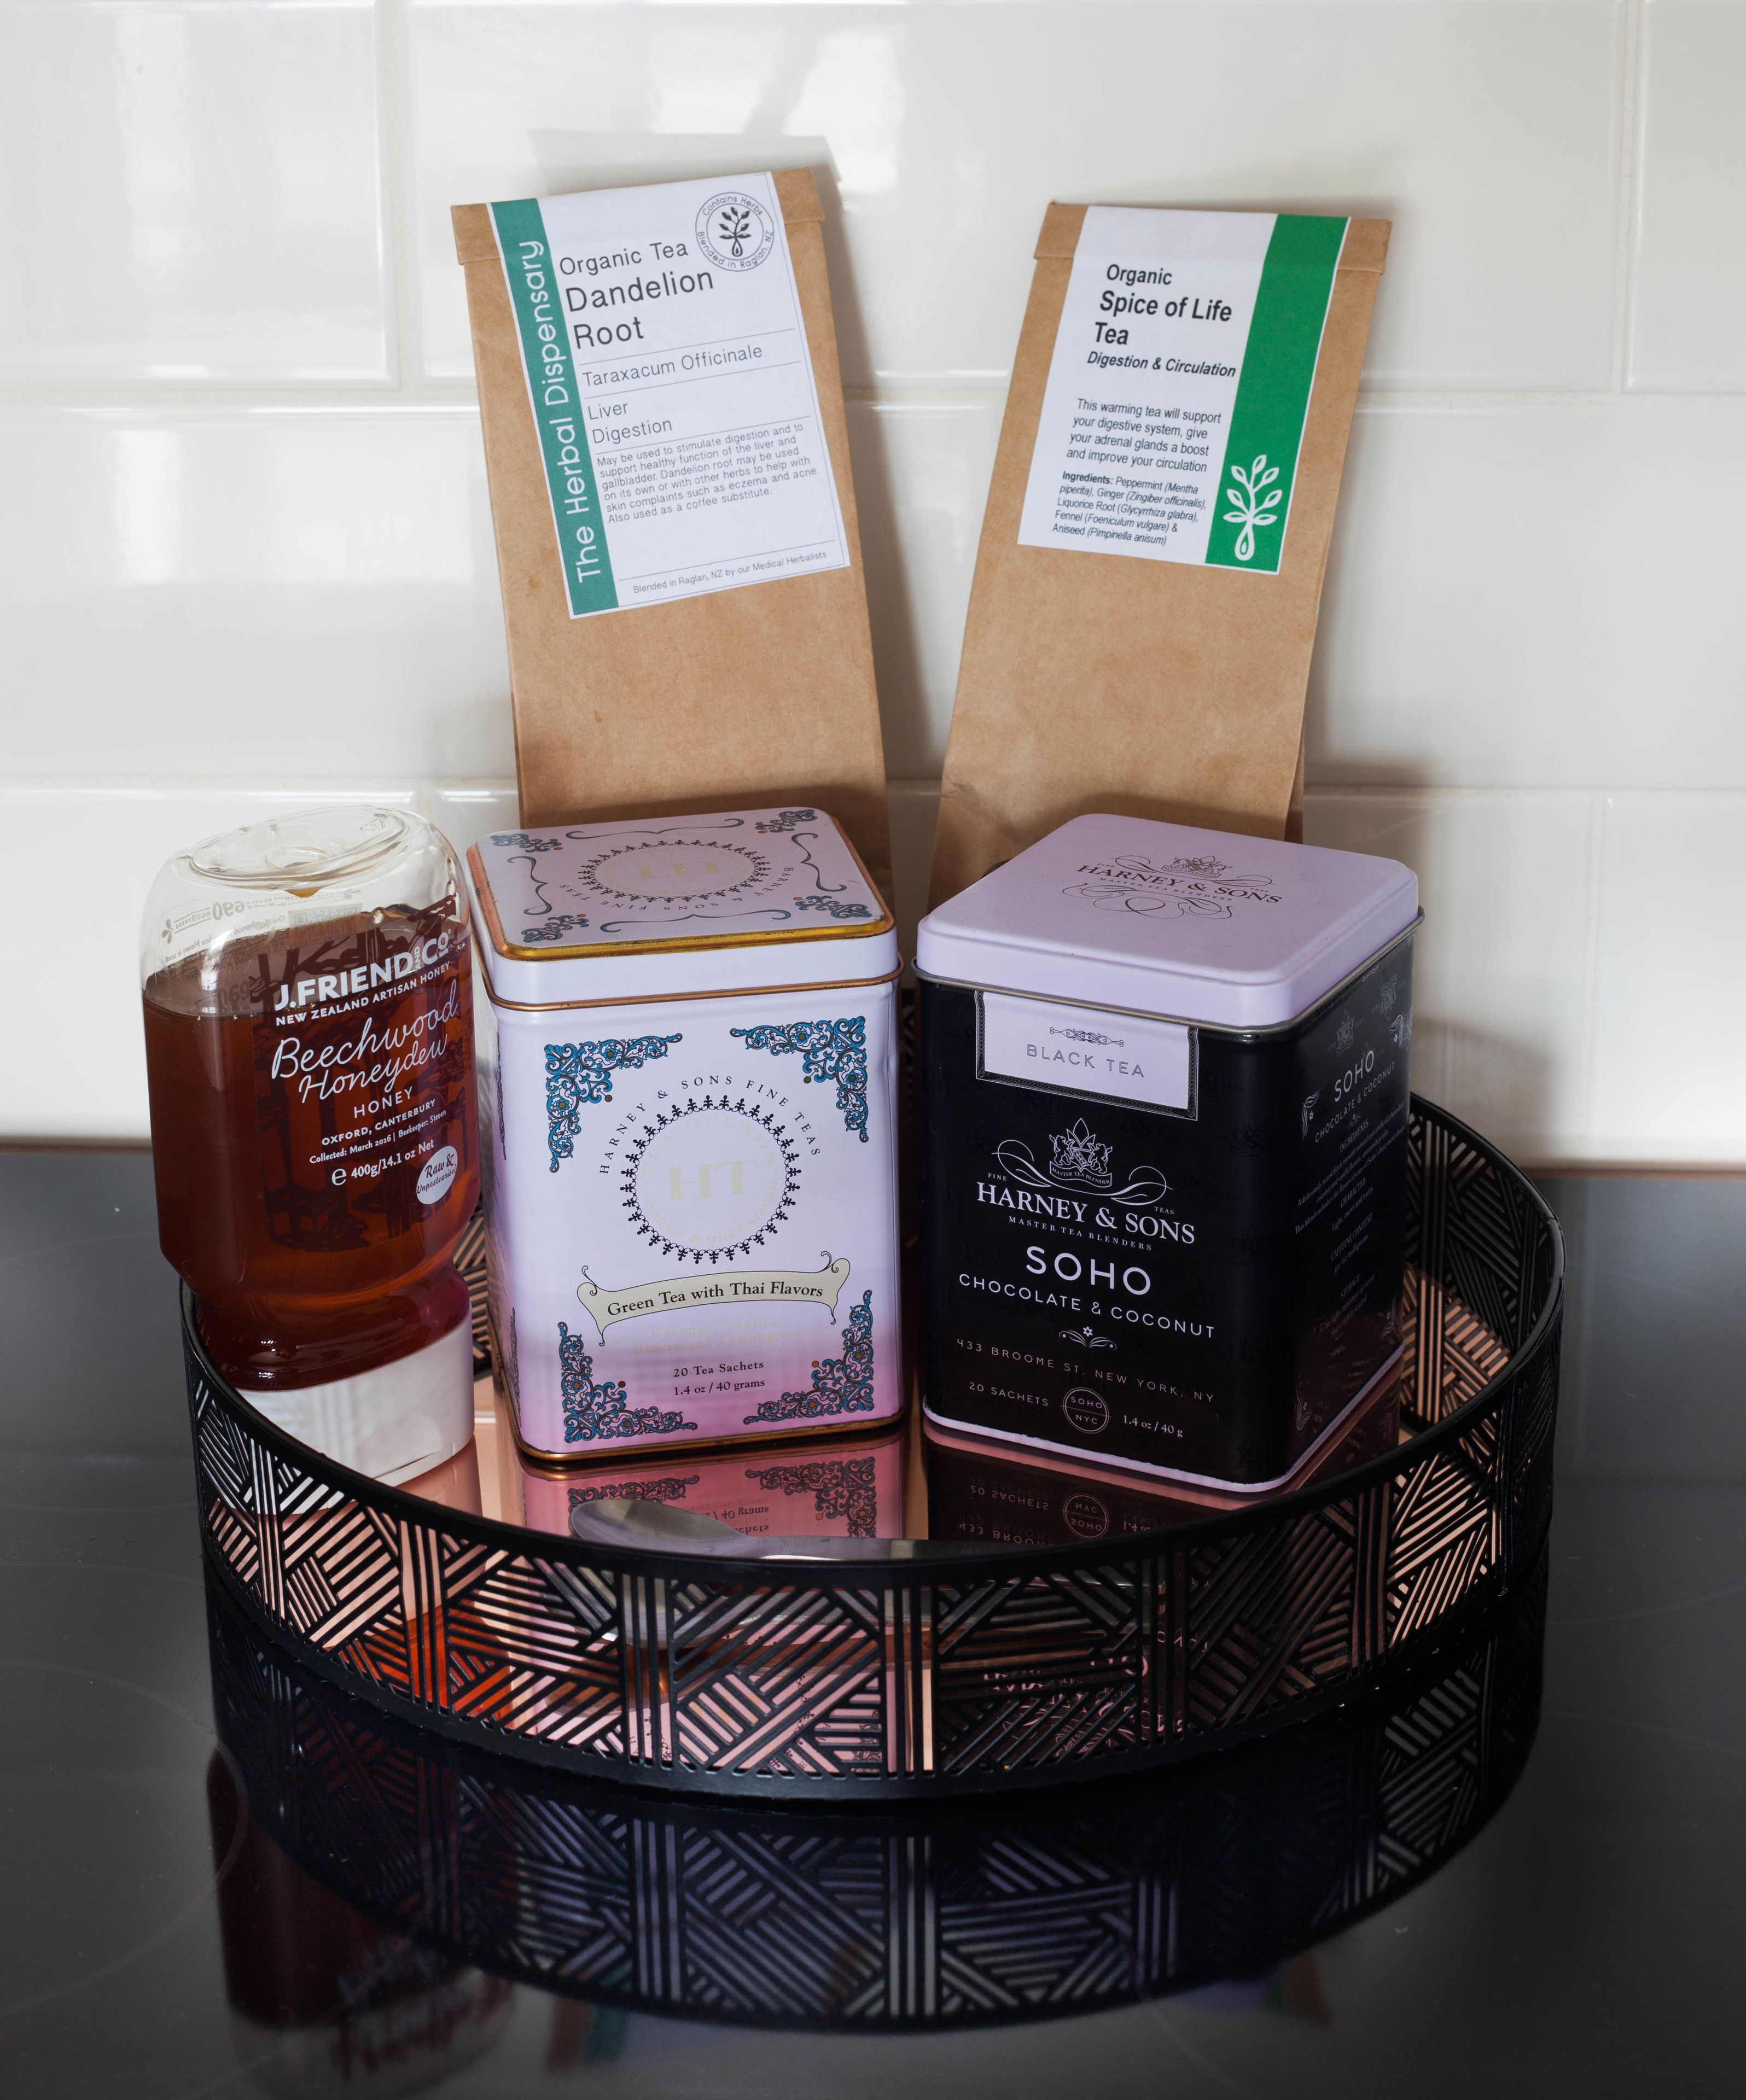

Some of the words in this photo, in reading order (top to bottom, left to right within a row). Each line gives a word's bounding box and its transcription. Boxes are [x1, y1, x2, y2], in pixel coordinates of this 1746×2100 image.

[560, 248, 641, 276] Organic
[649, 242, 688, 260] Tea
[1107, 264, 1172, 286] Organic
[566, 271, 713, 312] Dandelion
[1100, 290, 1158, 317] Spice
[1165, 297, 1188, 317] of
[1192, 299, 1231, 322] Life
[519, 241, 568, 405] Dispensary
[573, 317, 644, 349] Root
[1096, 322, 1128, 345] Tea
[582, 362, 675, 386] Taraxacum
[682, 345, 762, 370] Officinale
[1087, 351, 1148, 369] Digestion
[1152, 357, 1161, 370] &
[1166, 358, 1236, 377] Circulation
[588, 403, 627, 420] Liver
[1073, 417, 1095, 428] your
[1098, 417, 1142, 431] digestive
[1144, 424, 1182, 437] system,
[1186, 427, 1207, 440] give
[1078, 398, 1097, 410] This
[1101, 404, 1142, 418] warming
[1145, 406, 1161, 417] tea
[1165, 408, 1180, 418] will
[1183, 411, 1221, 424] support
[592, 420, 672, 444] Digestion
[597, 457, 616, 466] May
[620, 453, 633, 462] be
[636, 447, 660, 459] used
[663, 447, 673, 455] to
[677, 438, 721, 452] stimulate
[725, 430, 769, 445] digestion
[773, 424, 790, 435] and
[1069, 434, 1092, 444] your
[1095, 434, 1132, 447] adrenal
[1134, 438, 1168, 451] glands
[1171, 444, 1178, 452] a
[1180, 442, 1209, 456] boost
[549, 417, 589, 514] Herbal
[600, 464, 637, 478] support
[640, 458, 676, 470] healthy
[679, 451, 719, 463] function
[722, 446, 731, 456] of
[735, 445, 751, 453] the
[754, 440, 773, 450] liver
[778, 435, 796, 446] and
[602, 474, 657, 492] gallbladder.
[660, 464, 709, 479] Dandelion
[713, 458, 732, 469] root
[736, 456, 755, 465] may
[759, 453, 771, 461] be
[775, 446, 799, 458] used
[1067, 448, 1086, 459] and
[1088, 449, 1128, 463] improve
[1131, 456, 1154, 467] your
[1156, 457, 1207, 472] circulation
[606, 501, 626, 512] skin
[630, 492, 683, 508] complaints
[687, 486, 709, 498] such
[729, 477, 768, 489] eczema
[772, 471, 789, 482] and
[793, 468, 818, 479] acne.
[1062, 471, 1113, 484] Ingredients:
[1116, 476, 1162, 490] Peppermint
[1165, 482, 1198, 494] (Mentha
[608, 514, 630, 523] Also
[633, 506, 657, 518] used
[661, 506, 672, 514] as
[686, 497, 717, 509] coffee
[721, 488, 772, 503] substitute.
[576, 526, 601, 582] The
[1075, 865, 1185, 887] HARNEY
[1188, 883, 1206, 891] &
[1215, 887, 1282, 903] SONS
[275, 952, 414, 1011] J.FRIEND
[276, 1013, 307, 1026] NEW
[311, 996, 369, 1019] ZEALAND
[373, 979, 417, 1003] ARTISAN
[420, 961, 451, 983] HONEY
[271, 979, 458, 1079] Beechwood
[299, 1034, 447, 1104] Honeydew
[1026, 1043, 1095, 1070] BLACK
[1107, 1059, 1145, 1078] TEA
[1334, 1050, 1375, 1102] SOHO
[354, 1087, 412, 1118] HONEY
[310, 1149, 347, 1164] Collected:
[350, 1140, 373, 1154] March
[375, 1136, 391, 1146] 2016
[398, 1120, 428, 1138] Beekeeper:
[430, 1110, 446, 1124] Steven
[322, 1127, 372, 1145] OXFORD,
[375, 1099, 435, 1130] CANTERBURY
[600, 1101, 647, 1175] HARNEY
[657, 1089, 669, 1100] &
[682, 1076, 732, 1090] SONS
[746, 1080, 790, 1109] FINE
[794, 1111, 820, 1156] TEAS
[351, 1153, 402, 1178] 400g/14.1
[405, 1150, 416, 1160] oz
[418, 1140, 434, 1154] Net
[424, 1163, 444, 1178] Raw
[446, 1153, 455, 1168] &
[416, 1164, 457, 1194] Unpasteurised
[665, 1159, 758, 1201] HT
[988, 1172, 1008, 1182] FINE
[976, 1182, 1087, 1223] HARNEY
[1096, 1208, 1118, 1229] &
[1125, 1212, 1195, 1245] SONS
[1154, 1206, 1175, 1215] TEAS
[1009, 1216, 1056, 1231] MASTER
[1061, 1227, 1082, 1237] TEA
[1089, 1232, 1152, 1251] BLENDERS
[1026, 1246, 1150, 1295] SOHO
[607, 1297, 654, 1316] Green
[659, 1291, 686, 1305] Tea
[690, 1284, 724, 1300] with
[730, 1281, 766, 1296] Thai
[770, 1282, 824, 1297] Flavors
[959, 1274, 1081, 1311] CHOCOLATE
[1091, 1302, 1101, 1315] &
[1111, 1306, 1215, 1338] COCONUT
[673, 1367, 689, 1378] 20
[694, 1365, 714, 1375] Tea
[719, 1361, 764, 1373] Sachets
[957, 1338, 982, 1352] 433
[992, 1347, 1054, 1368] BROOME
[1064, 1363, 1085, 1375] ST.
[1095, 1370, 1127, 1384] NEW
[1137, 1379, 1183, 1398] YORK,
[1194, 1391, 1215, 1402] NY
[673, 1384, 690, 1396] 1.4
[694, 1384, 706, 1394] oz
[708, 1382, 713, 1393] /
[716, 1381, 730, 1392] 40
[734, 1379, 765, 1392] grams
[969, 1382, 984, 1392] 20
[991, 1387, 1049, 1406] SACHETS
[1071, 1396, 1103, 1409] SOHO
[1075, 1414, 1098, 1425] NYC
[1123, 1415, 1138, 1427] 1.4
[1141, 1421, 1152, 1429] oz
[1154, 1421, 1159, 1431] /
[1161, 1424, 1174, 1434] 40
[1177, 1427, 1183, 1438] g
